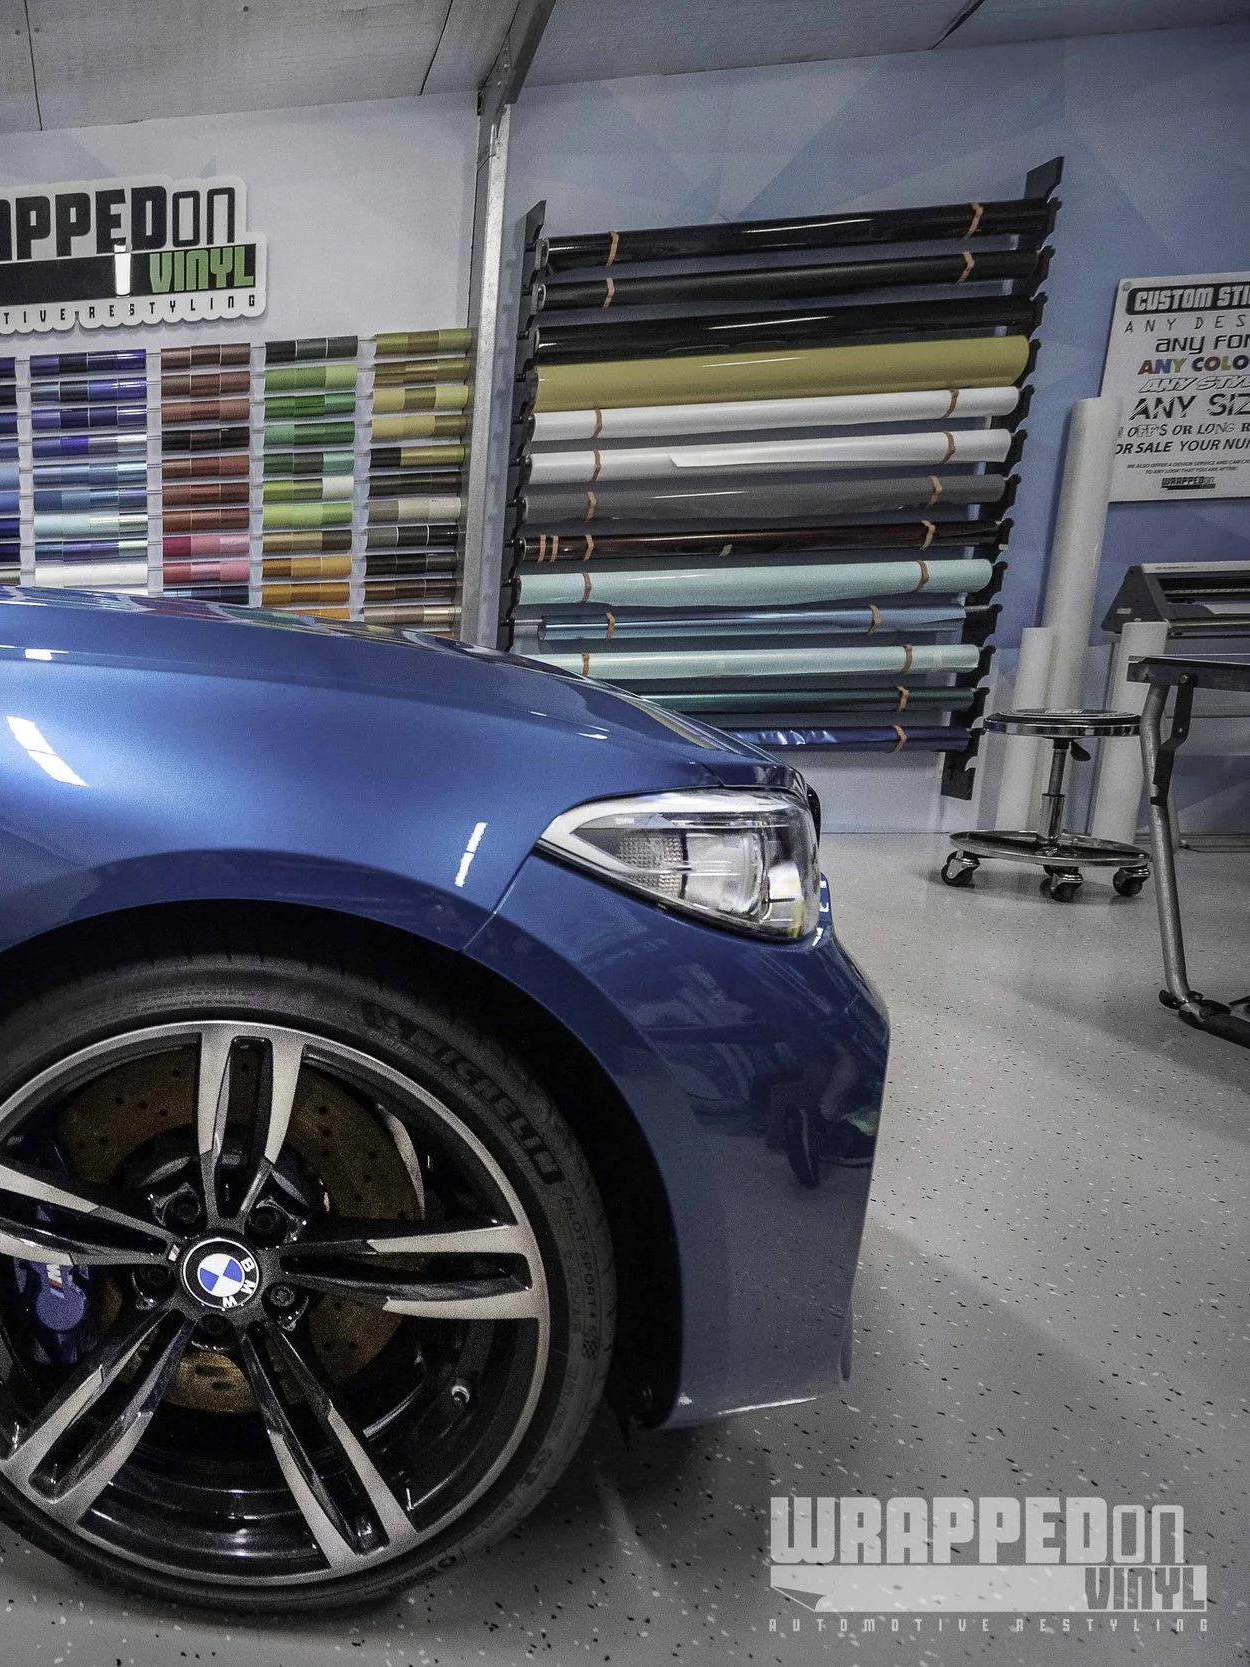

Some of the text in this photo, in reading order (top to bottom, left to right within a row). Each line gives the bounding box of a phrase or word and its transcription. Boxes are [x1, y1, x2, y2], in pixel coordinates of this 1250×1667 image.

[150, 245, 255, 294] VINYL
[89, 295, 255, 320] RESTYLING
[1134, 285, 1250, 312] CUSTOM STI
[1125, 318, 1177, 333] ANY
[1137, 355, 1250, 375] ANY COLO
[1138, 378, 1198, 393] ANY
[1129, 395, 1198, 420] ANY
[1173, 425, 1192, 435] OR
[1134, 441, 1174, 453] SALE
[1180, 439, 1221, 451] YOUR
[410, 1029, 557, 1173] MICHELIN
[223, 1257, 256, 1307] BMW
